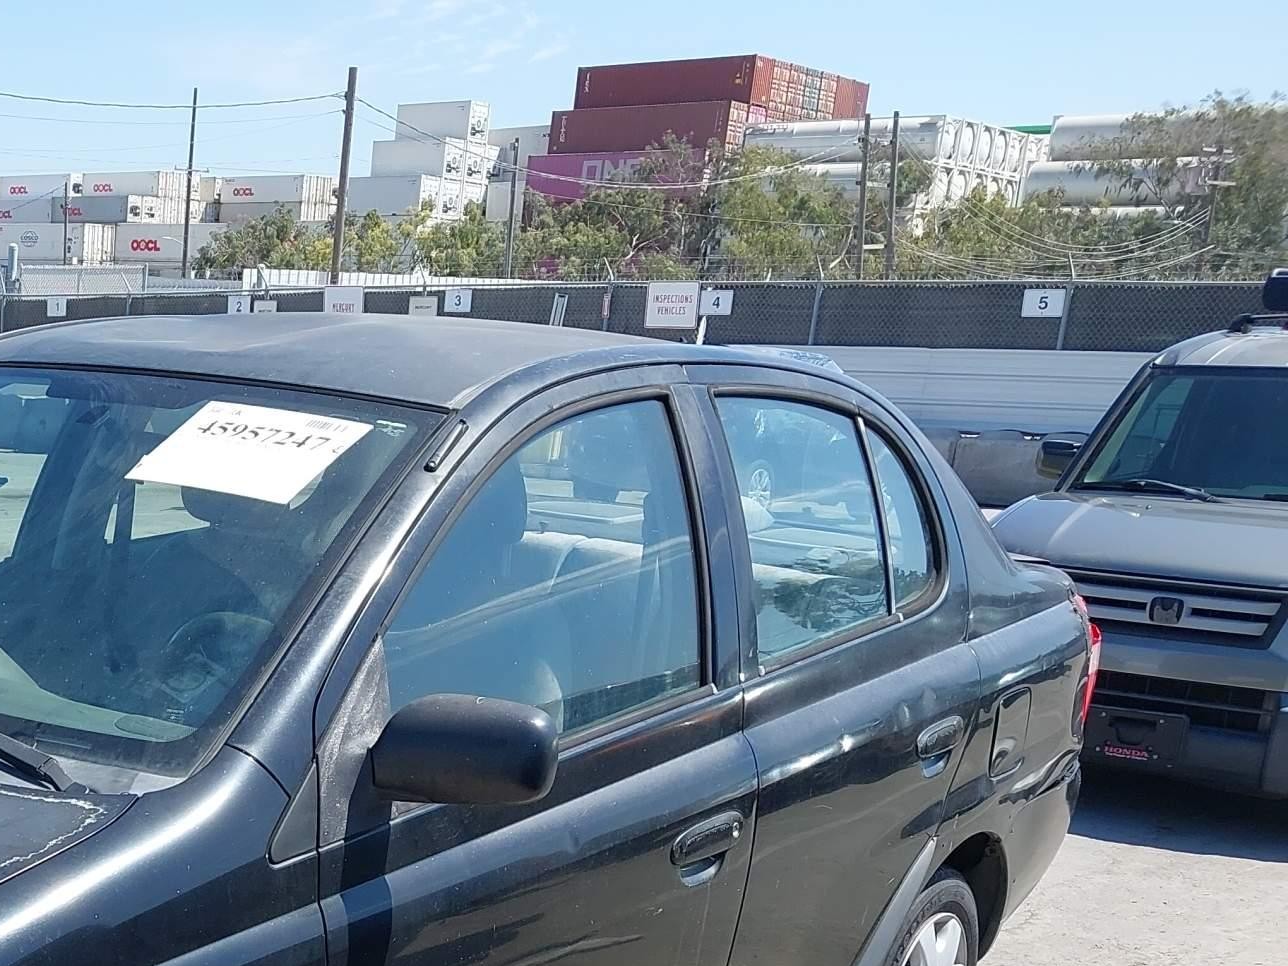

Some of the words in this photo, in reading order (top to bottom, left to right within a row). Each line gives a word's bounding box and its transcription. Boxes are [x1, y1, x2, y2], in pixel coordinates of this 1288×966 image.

[10, 186, 28, 194] OOCL
[93, 183, 113, 192] OOCL
[233, 187, 254, 196] OOCL
[131, 239, 160, 252] OOCL
[454, 295, 461, 307] 3
[652, 294, 694, 304] INSPECTIONS
[712, 296, 721, 310] 4
[1038, 296, 1049, 310] 5
[55, 302, 60, 312] 1
[236, 301, 242, 313] 2
[332, 303, 355, 313] MERCURY
[657, 306, 686, 316] VEHICLES
[197, 420, 331, 451] 45957247
[1103, 746, 1149, 758] HONDA
